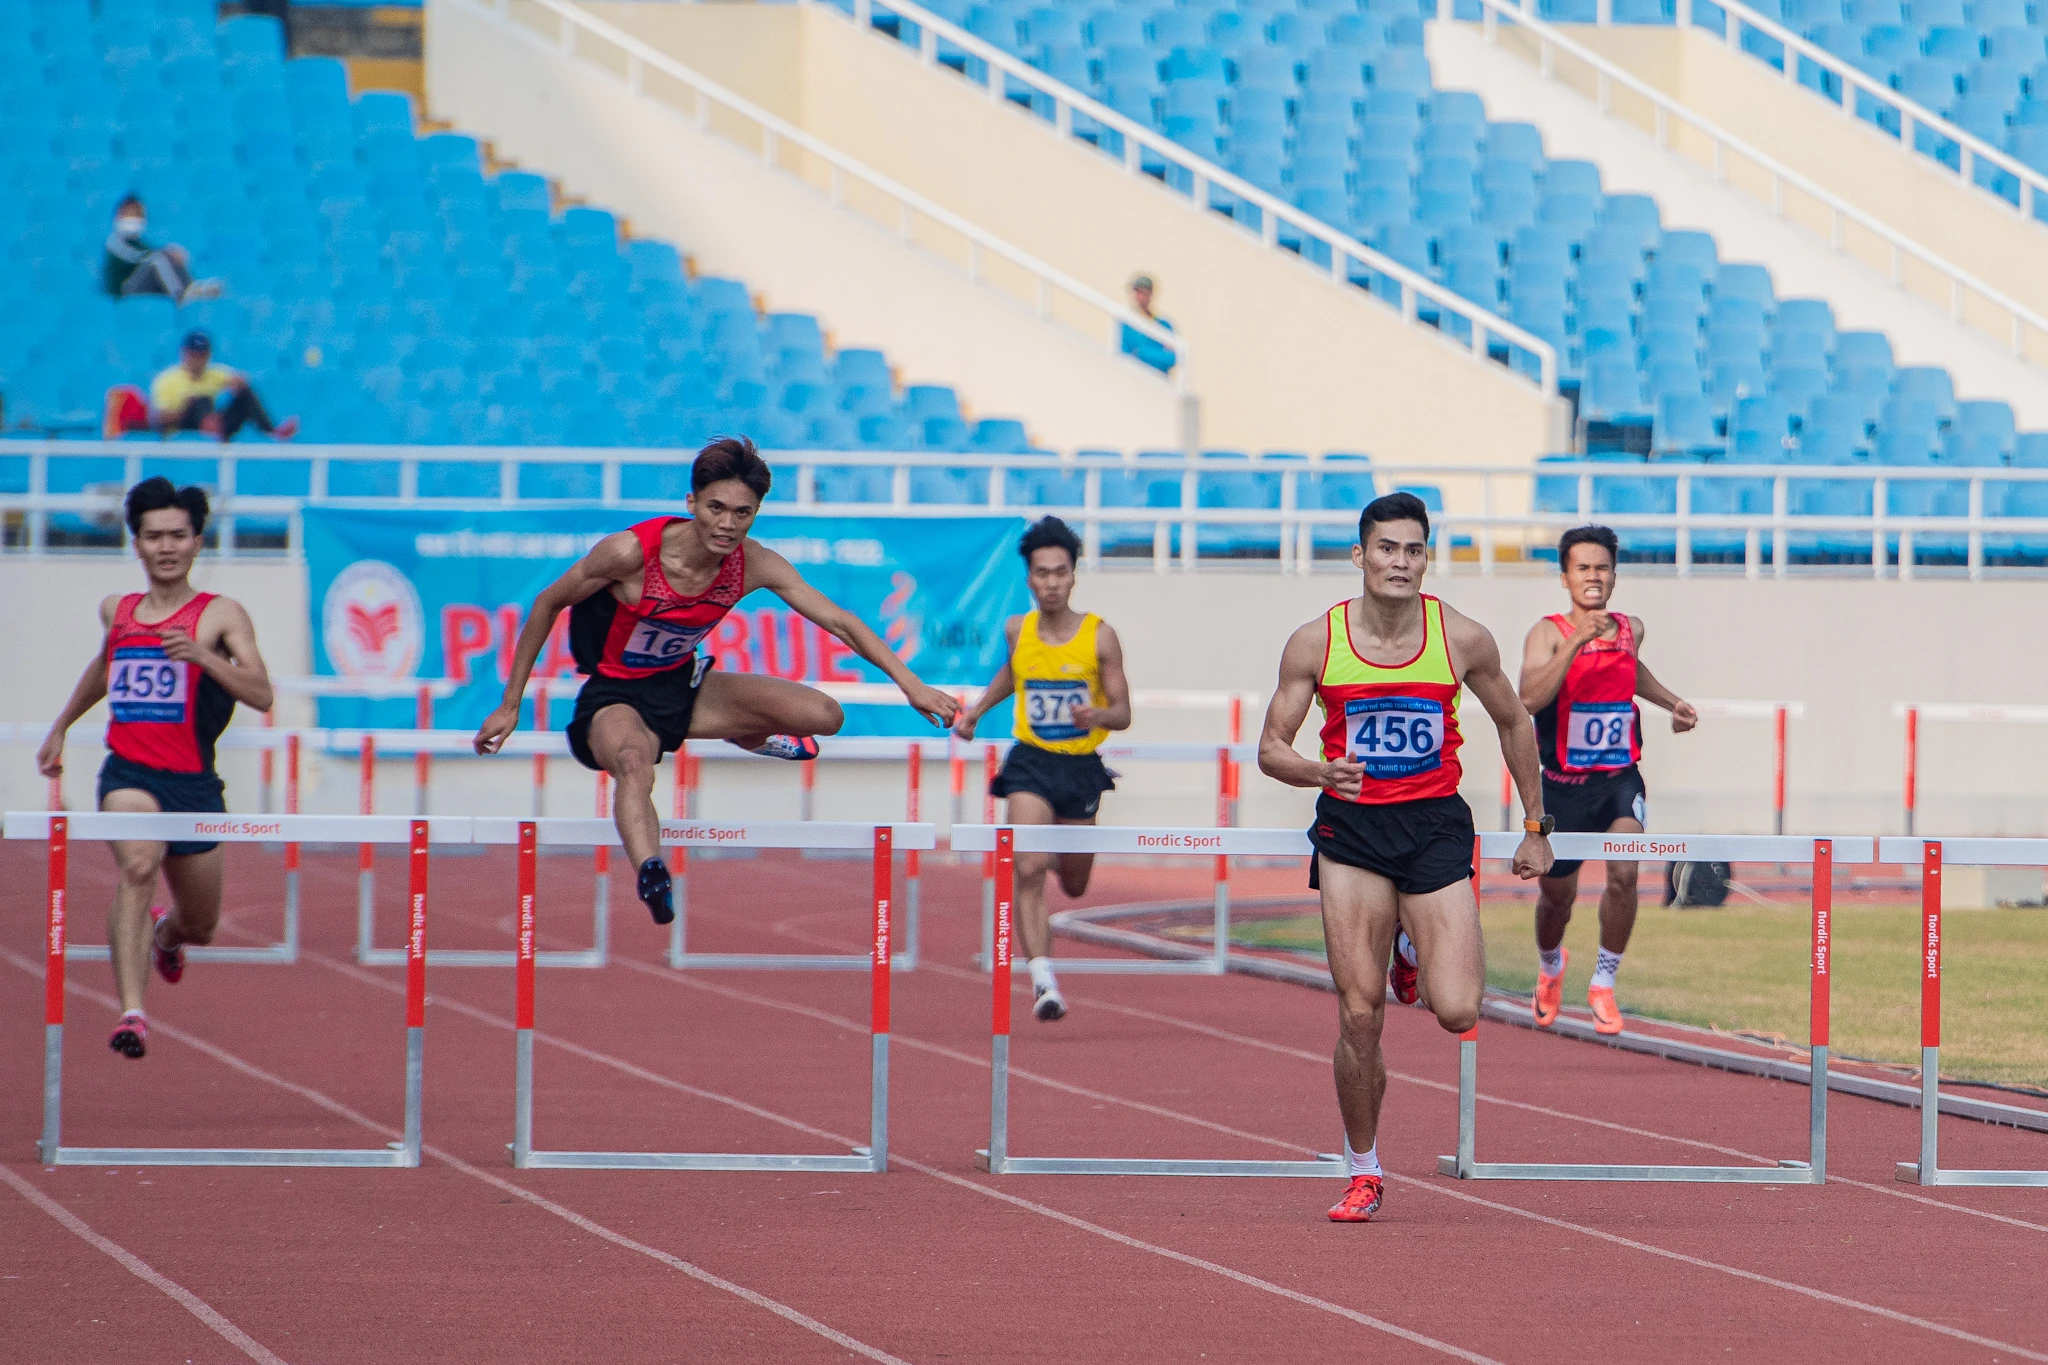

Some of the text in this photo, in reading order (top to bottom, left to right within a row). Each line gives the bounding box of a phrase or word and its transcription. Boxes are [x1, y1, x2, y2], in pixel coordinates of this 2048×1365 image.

[112, 664, 176, 698] 459
[1355, 715, 1434, 754] 456
[1584, 717, 1623, 746] 08
[1400, 764, 1407, 772] 12
[242, 822, 281, 837] Sport
[708, 827, 746, 842] Sport
[1184, 835, 1222, 849] Sport
[1649, 841, 1687, 857] Sport
[875, 935, 888, 965] Sport
[996, 937, 1009, 967] Sport
[1815, 945, 1827, 975] Sport
[1926, 949, 1938, 979] Sport
